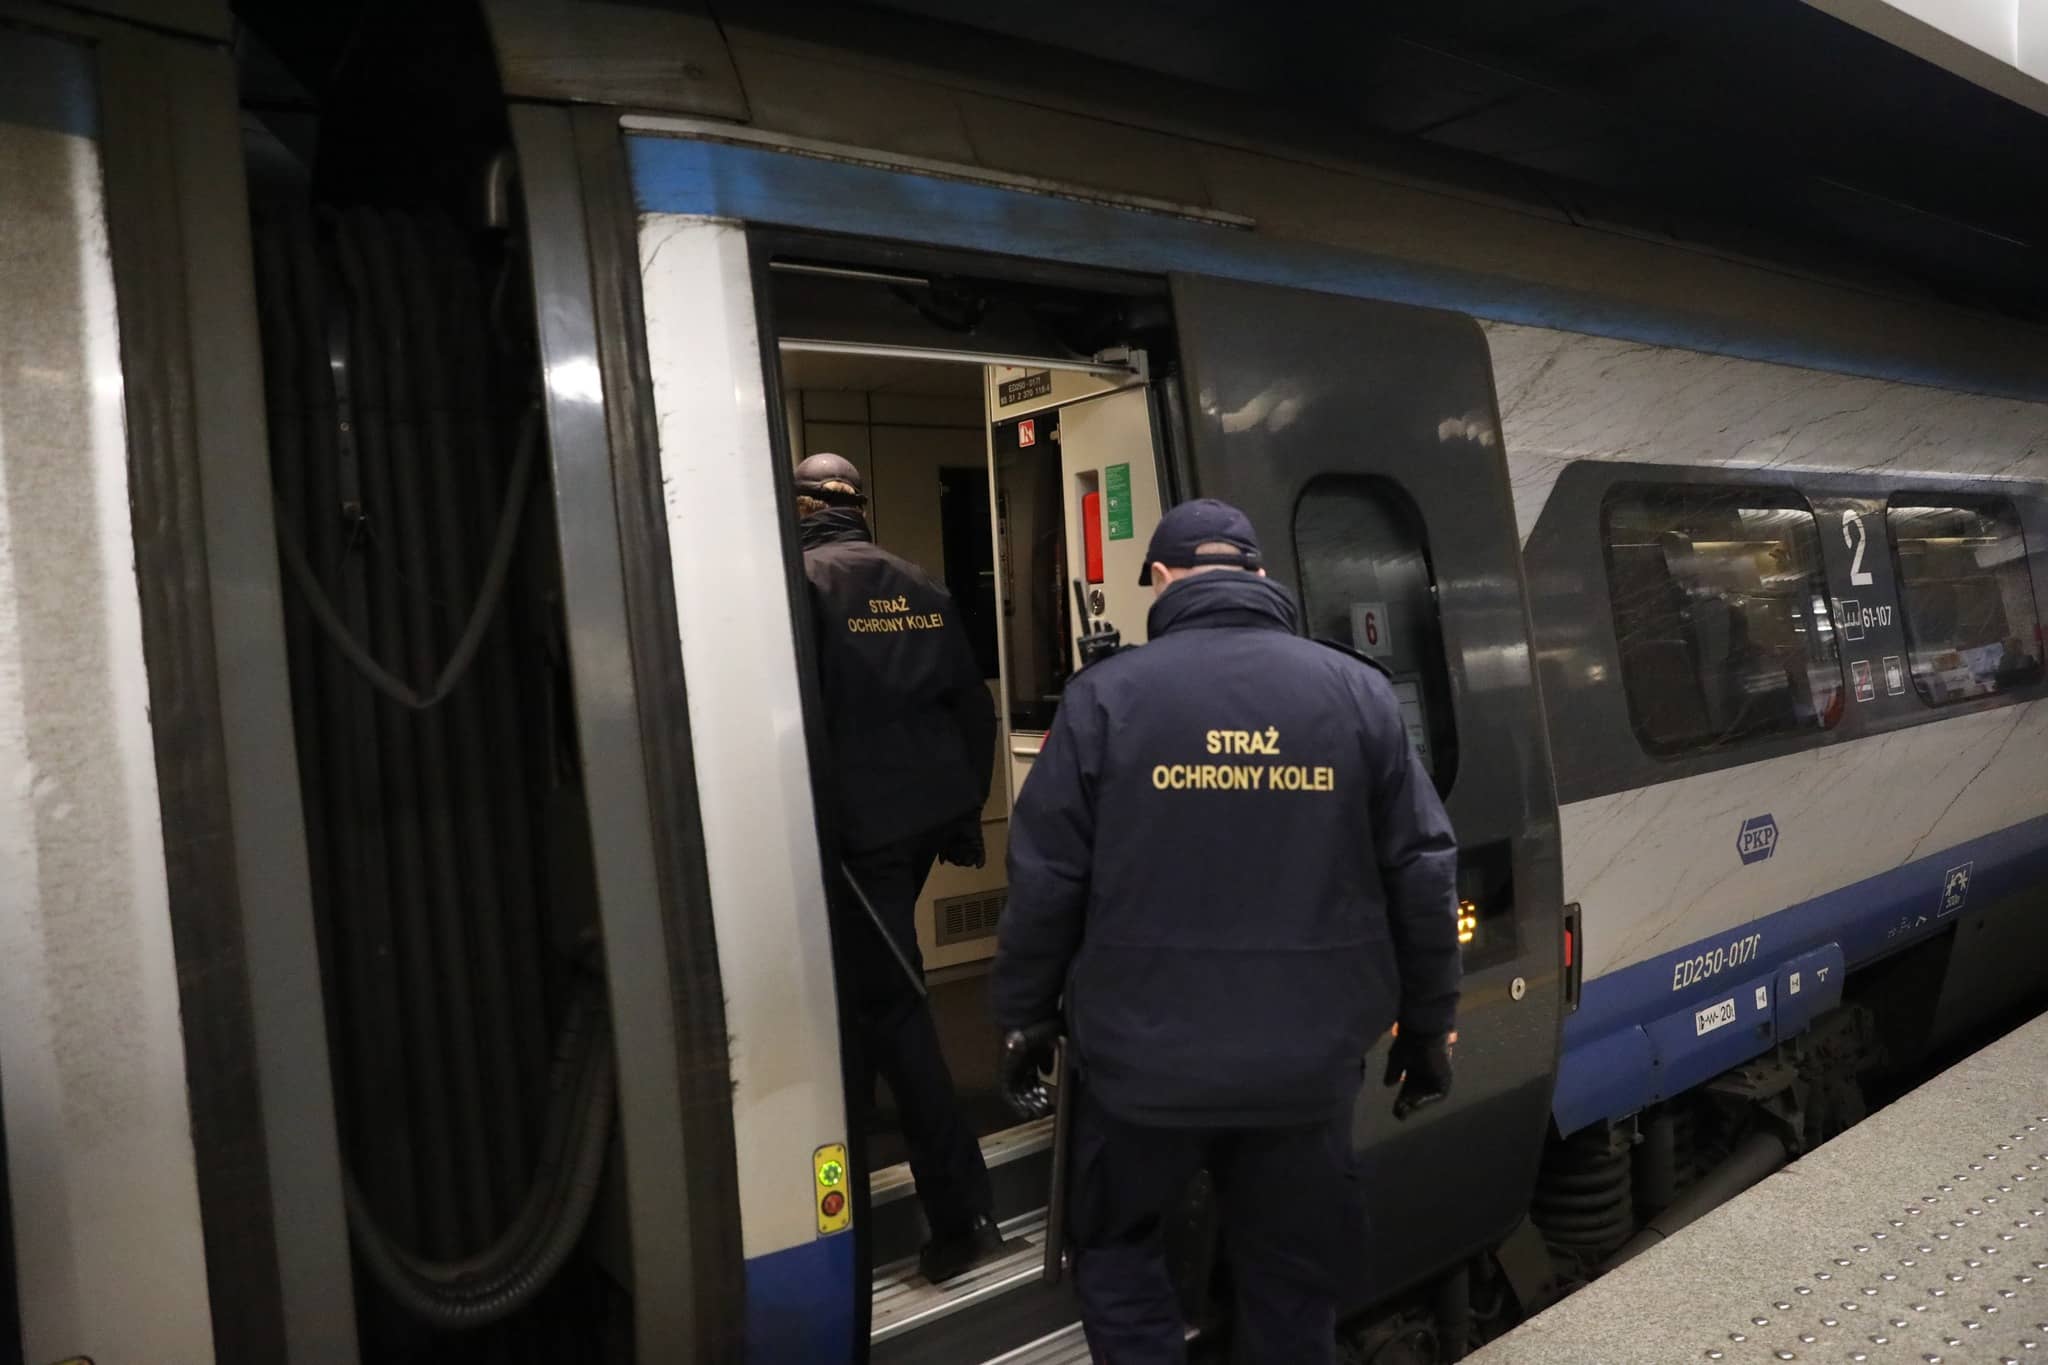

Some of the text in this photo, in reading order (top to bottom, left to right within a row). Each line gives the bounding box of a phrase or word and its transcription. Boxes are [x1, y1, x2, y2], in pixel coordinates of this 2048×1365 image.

[1842, 509, 1873, 586] 2
[868, 595, 910, 613] STRAŻ
[1862, 605, 1892, 628] 61-107
[847, 613, 944, 632] OCHRONY KOLEI
[1365, 611, 1378, 645] 6
[1206, 725, 1280, 755] STRAŻ
[1152, 765, 1335, 791] OCHRONY KOLEI
[1743, 827, 1773, 852] PKP
